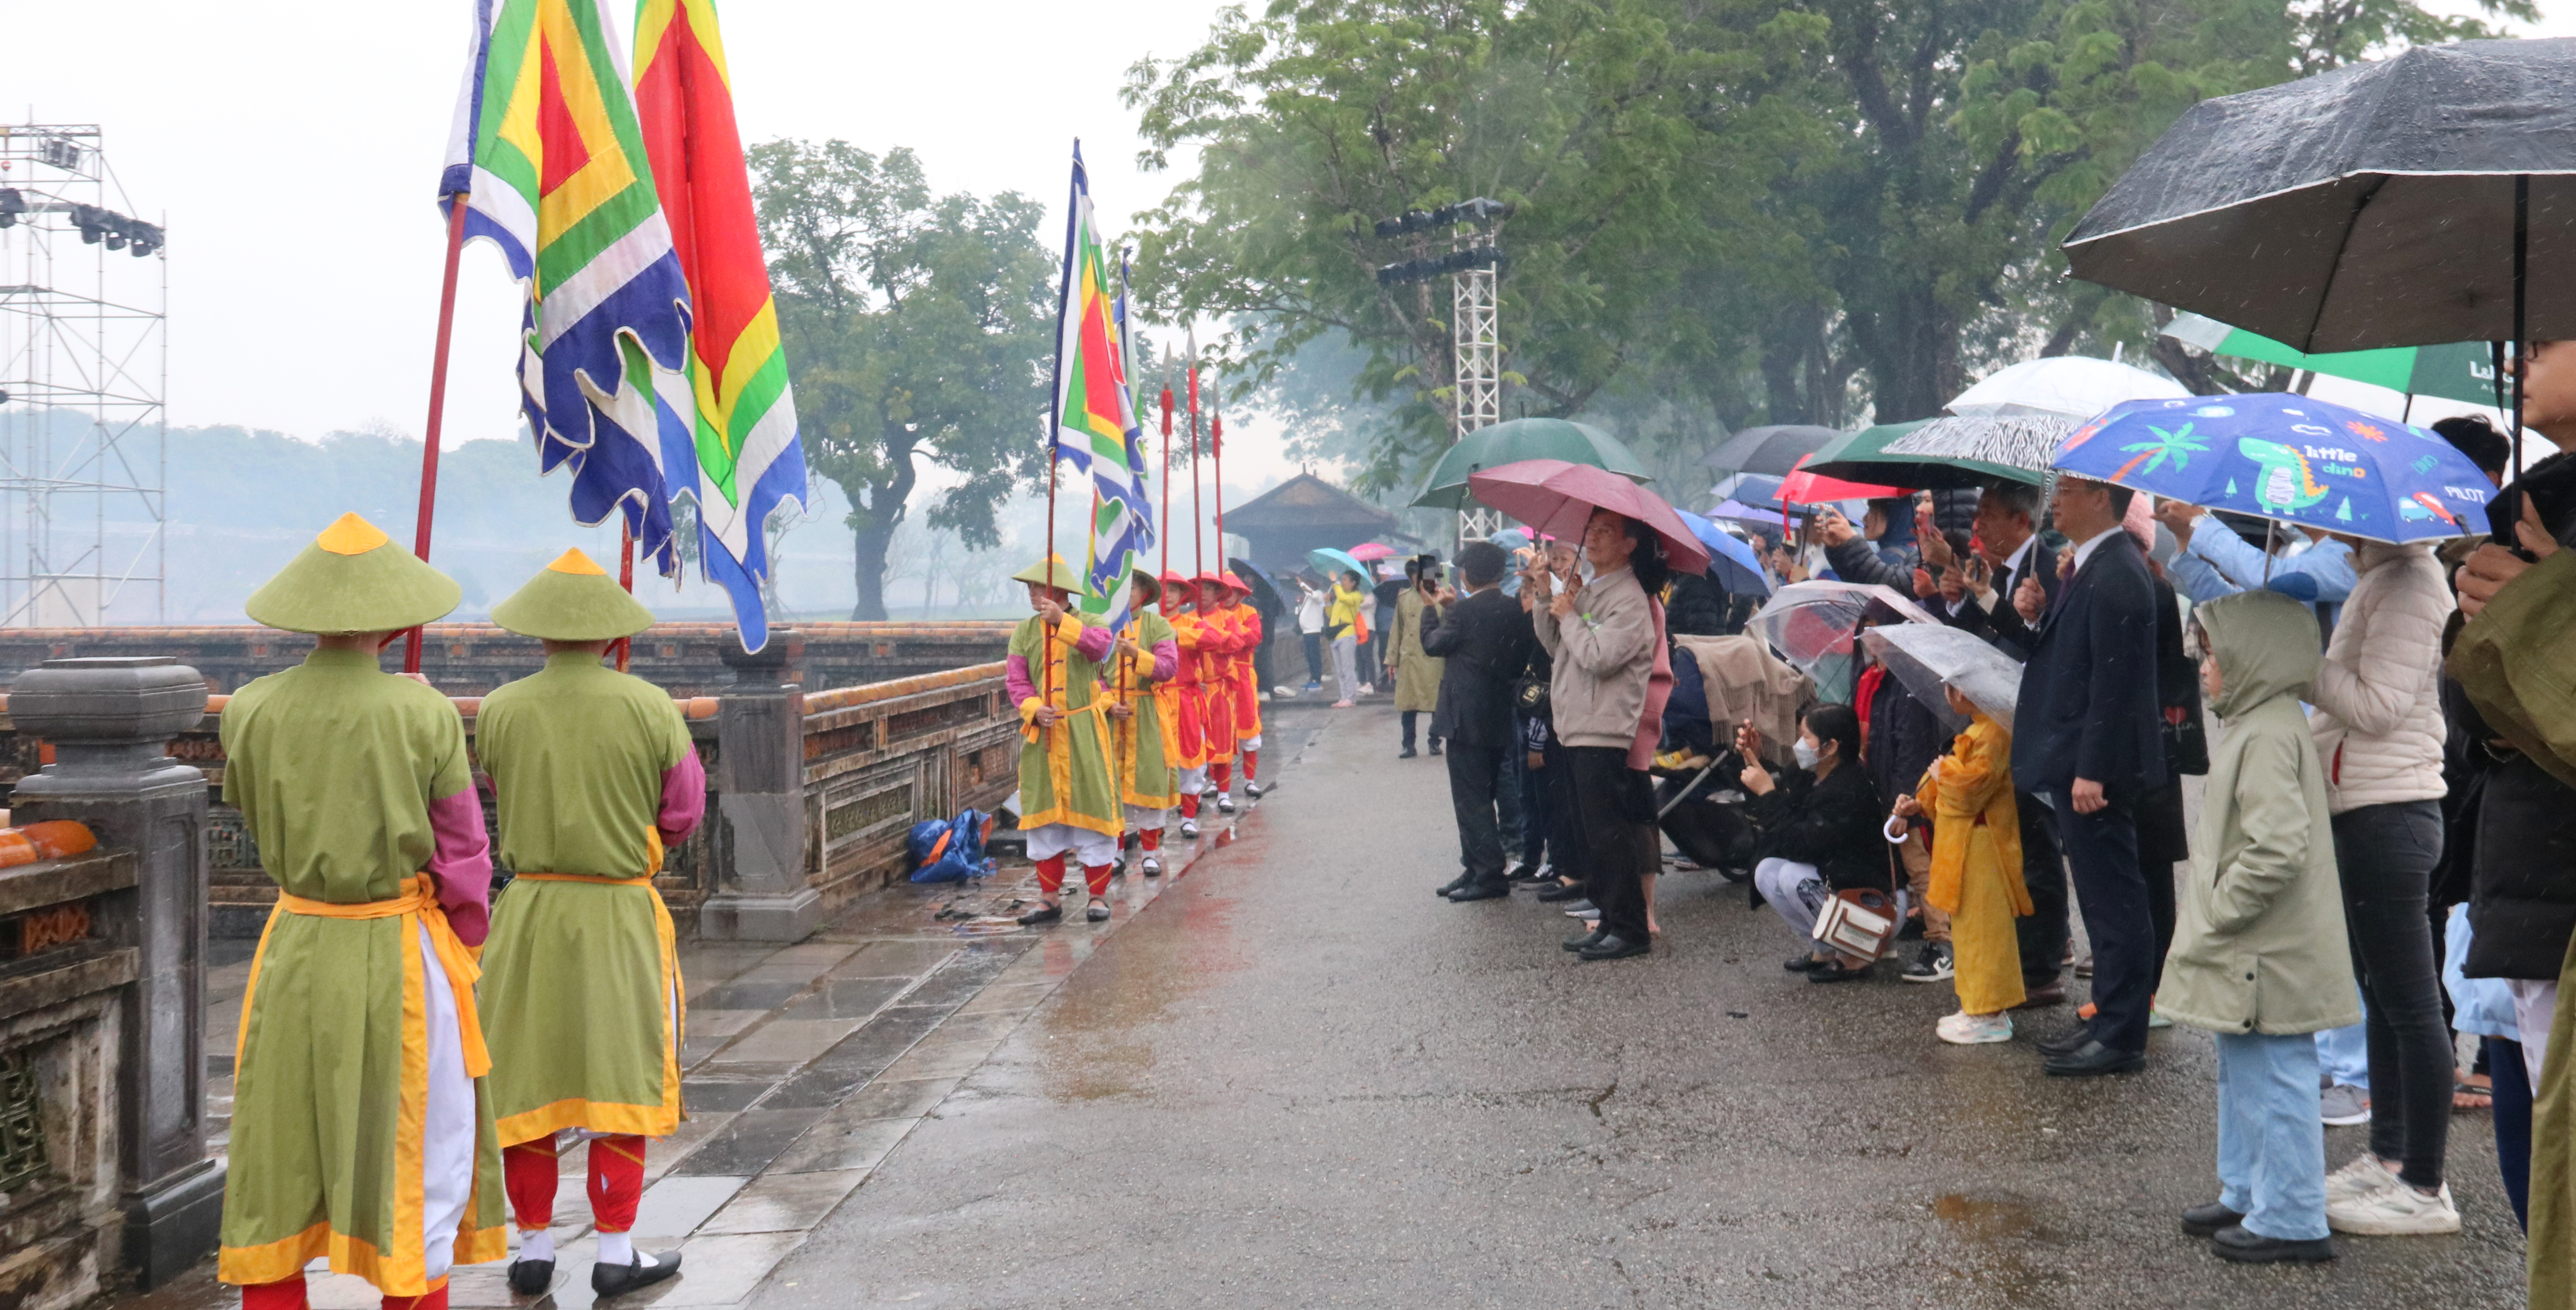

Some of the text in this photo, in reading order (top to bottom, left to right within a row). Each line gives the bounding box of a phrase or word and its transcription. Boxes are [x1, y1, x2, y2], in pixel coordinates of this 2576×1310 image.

[2304, 445, 2358, 462] little
[2322, 461, 2366, 479] dino
[2411, 454, 2439, 475] DINO
[2444, 486, 2485, 505] PILOT
